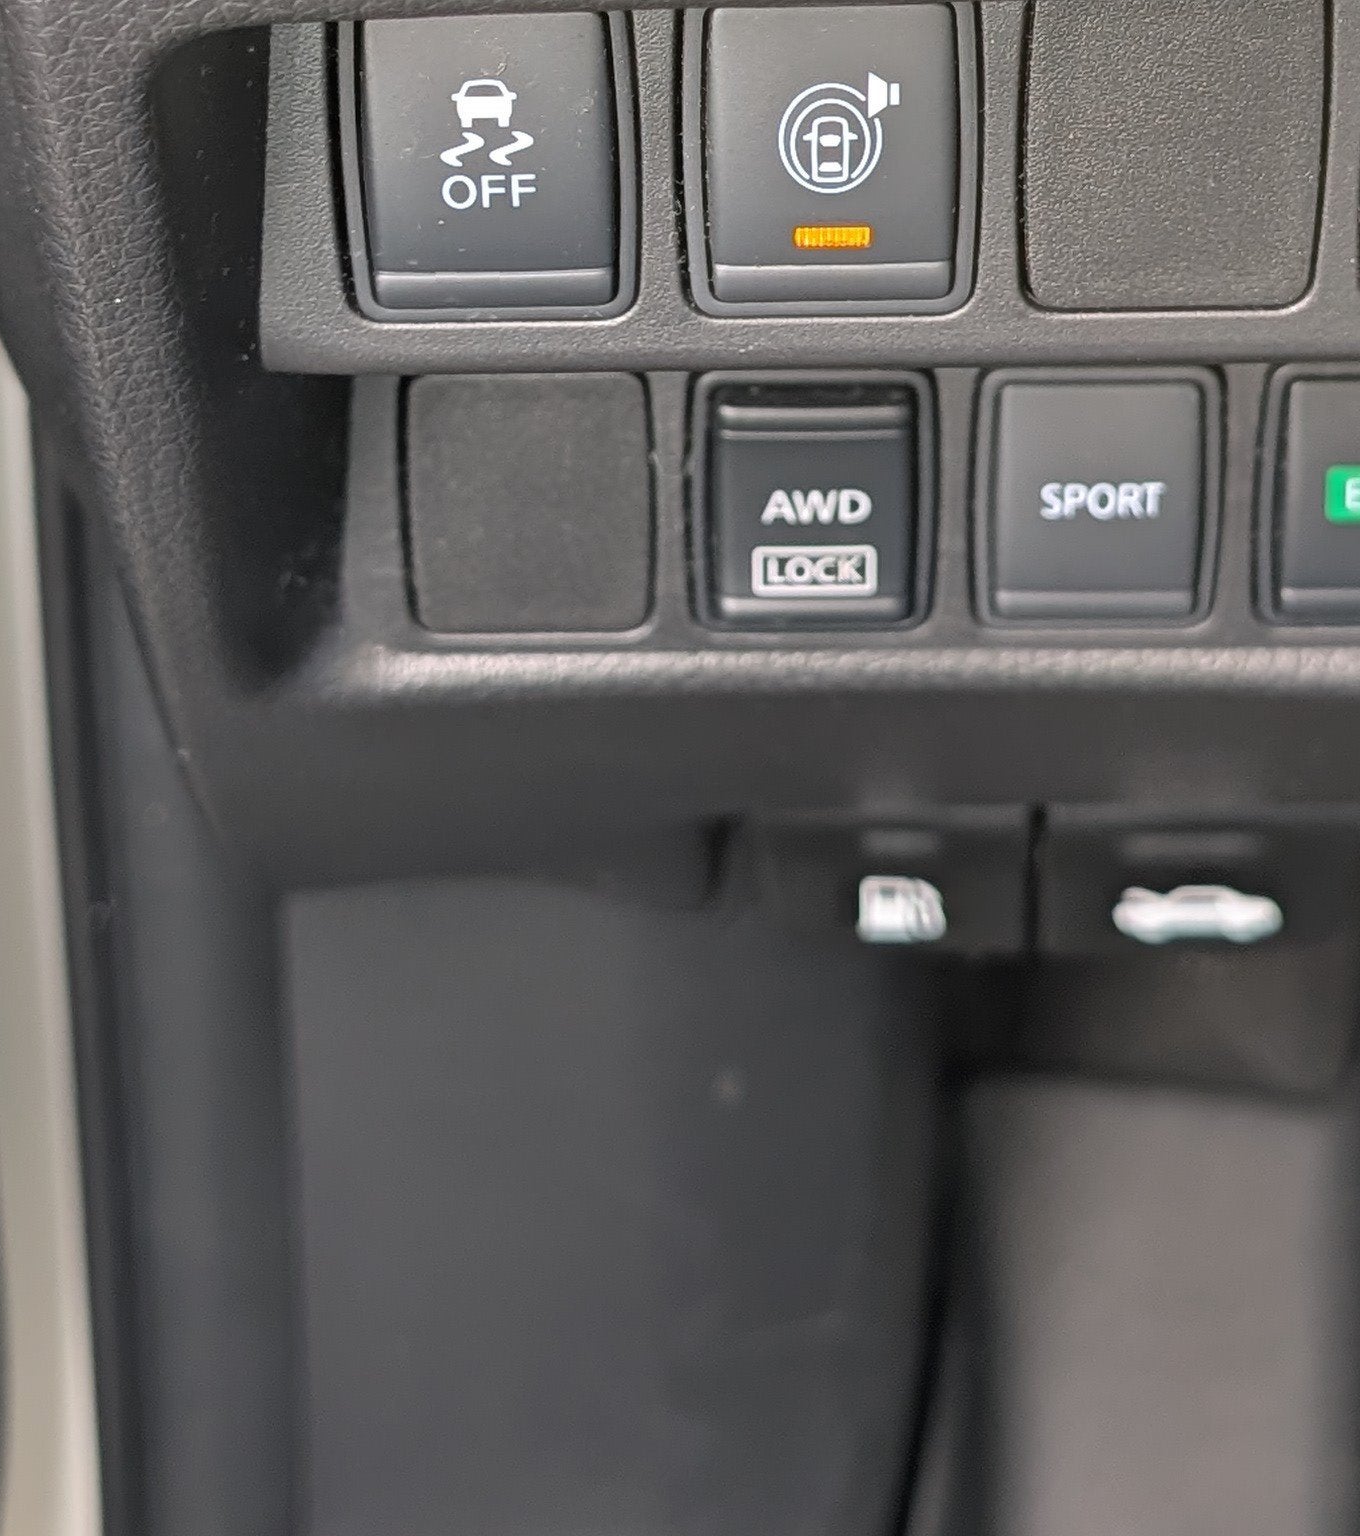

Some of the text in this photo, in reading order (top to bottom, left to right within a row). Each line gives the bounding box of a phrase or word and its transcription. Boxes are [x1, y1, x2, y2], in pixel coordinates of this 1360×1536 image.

[441, 173, 537, 210] OFF
[761, 488, 872, 524] AWD
[1040, 481, 1165, 520] SPORT
[765, 555, 862, 585] LOCK
